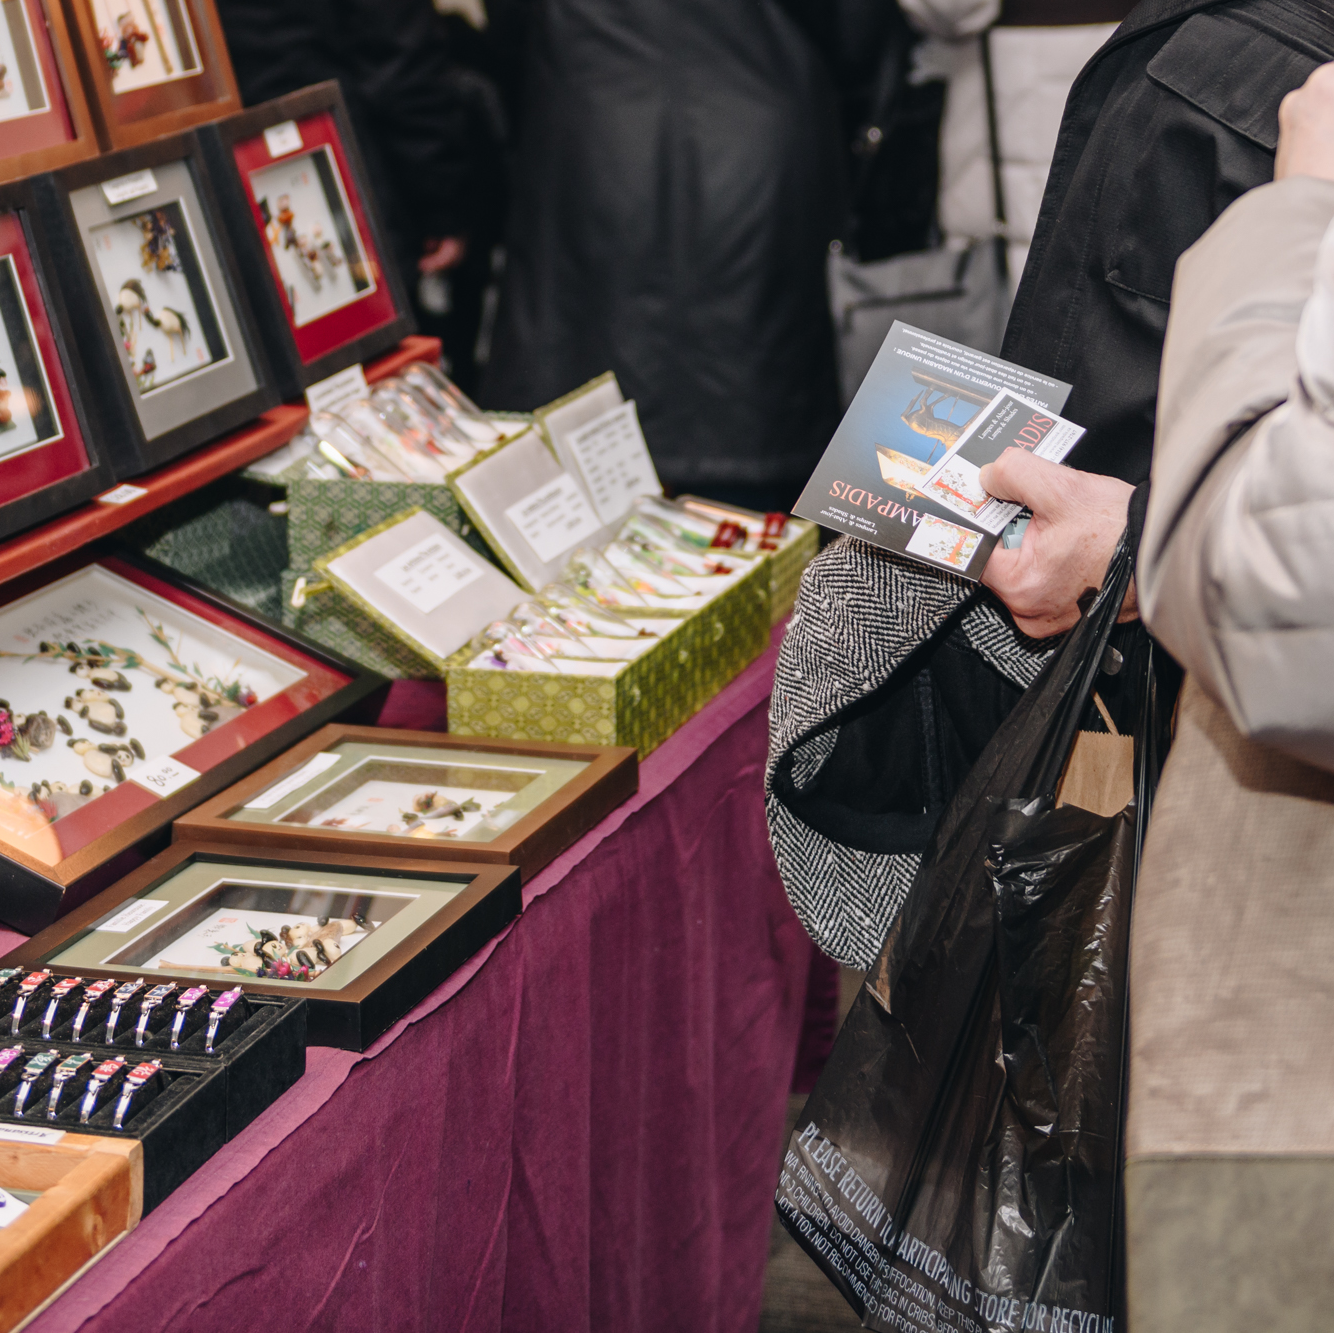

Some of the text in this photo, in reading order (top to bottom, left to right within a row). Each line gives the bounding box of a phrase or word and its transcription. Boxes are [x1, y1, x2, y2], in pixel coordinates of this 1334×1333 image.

[896, 349, 922, 361] UNIQUE
[923, 358, 952, 373] MAGASIN
[971, 376, 1000, 391] OUVERTE
[978, 423, 995, 440] Lampes
[988, 426, 1003, 441] Lamps
[1013, 413, 1053, 449] ADIS
[829, 480, 926, 527] AMPADIS
[820, 509, 848, 523] Abat-jour
[828, 506, 849, 518] Shades
[855, 522, 878, 535] Lampes
[856, 516, 876, 528] Lamps
[798, 1121, 848, 1182] PLEASE
[838, 1167, 887, 1229] RETURN
[889, 1229, 972, 1305] PARTICIPAING
[974, 1288, 1020, 1328] STORE
[784, 1150, 822, 1197] WARNING:
[821, 1190, 834, 1210] TO
[829, 1201, 854, 1233] AVOID
[850, 1226, 880, 1262] DANGER
[956, 1311, 975, 1333] THIS
[789, 1207, 798, 1221] A
[794, 1213, 815, 1239] TOY.
[810, 1231, 833, 1255] NOT
[878, 1303, 897, 1324] FOR
[793, 1186, 831, 1233] CHILDREN.
[829, 1225, 841, 1245] DO
[839, 1239, 859, 1264] NOT
[855, 1256, 874, 1280] USE
[882, 1283, 899, 1305] BAG
[898, 1294, 909, 1311] IN
[907, 1301, 938, 1331] CRIBS,
